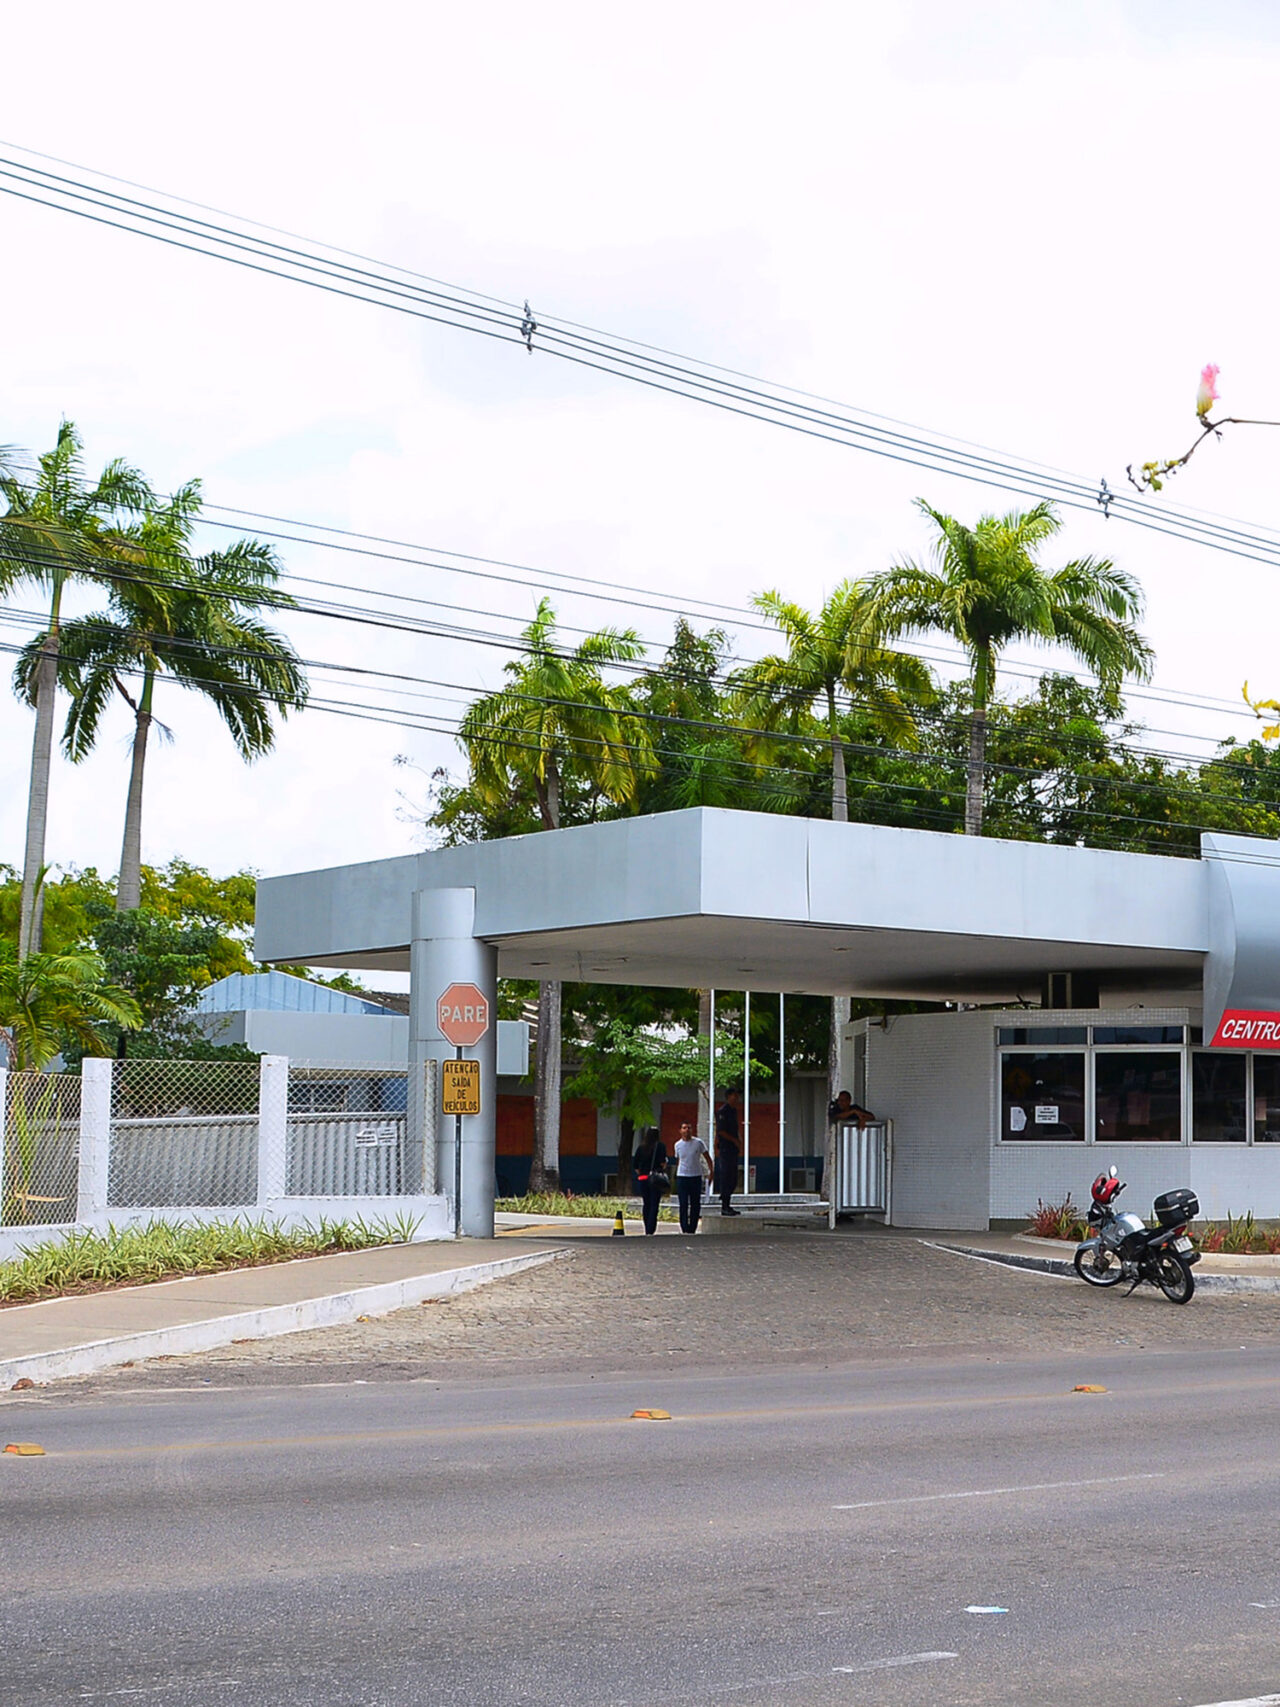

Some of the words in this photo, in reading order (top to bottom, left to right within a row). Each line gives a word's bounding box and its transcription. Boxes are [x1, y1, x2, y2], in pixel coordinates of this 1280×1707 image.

[441, 1005, 485, 1022] PARE
[444, 1063, 478, 1075] ATENÇÃO
[451, 1076, 471, 1087] SAÍDA
[457, 1089, 466, 1100] DE
[444, 1100, 478, 1112] VEÍCULOS
